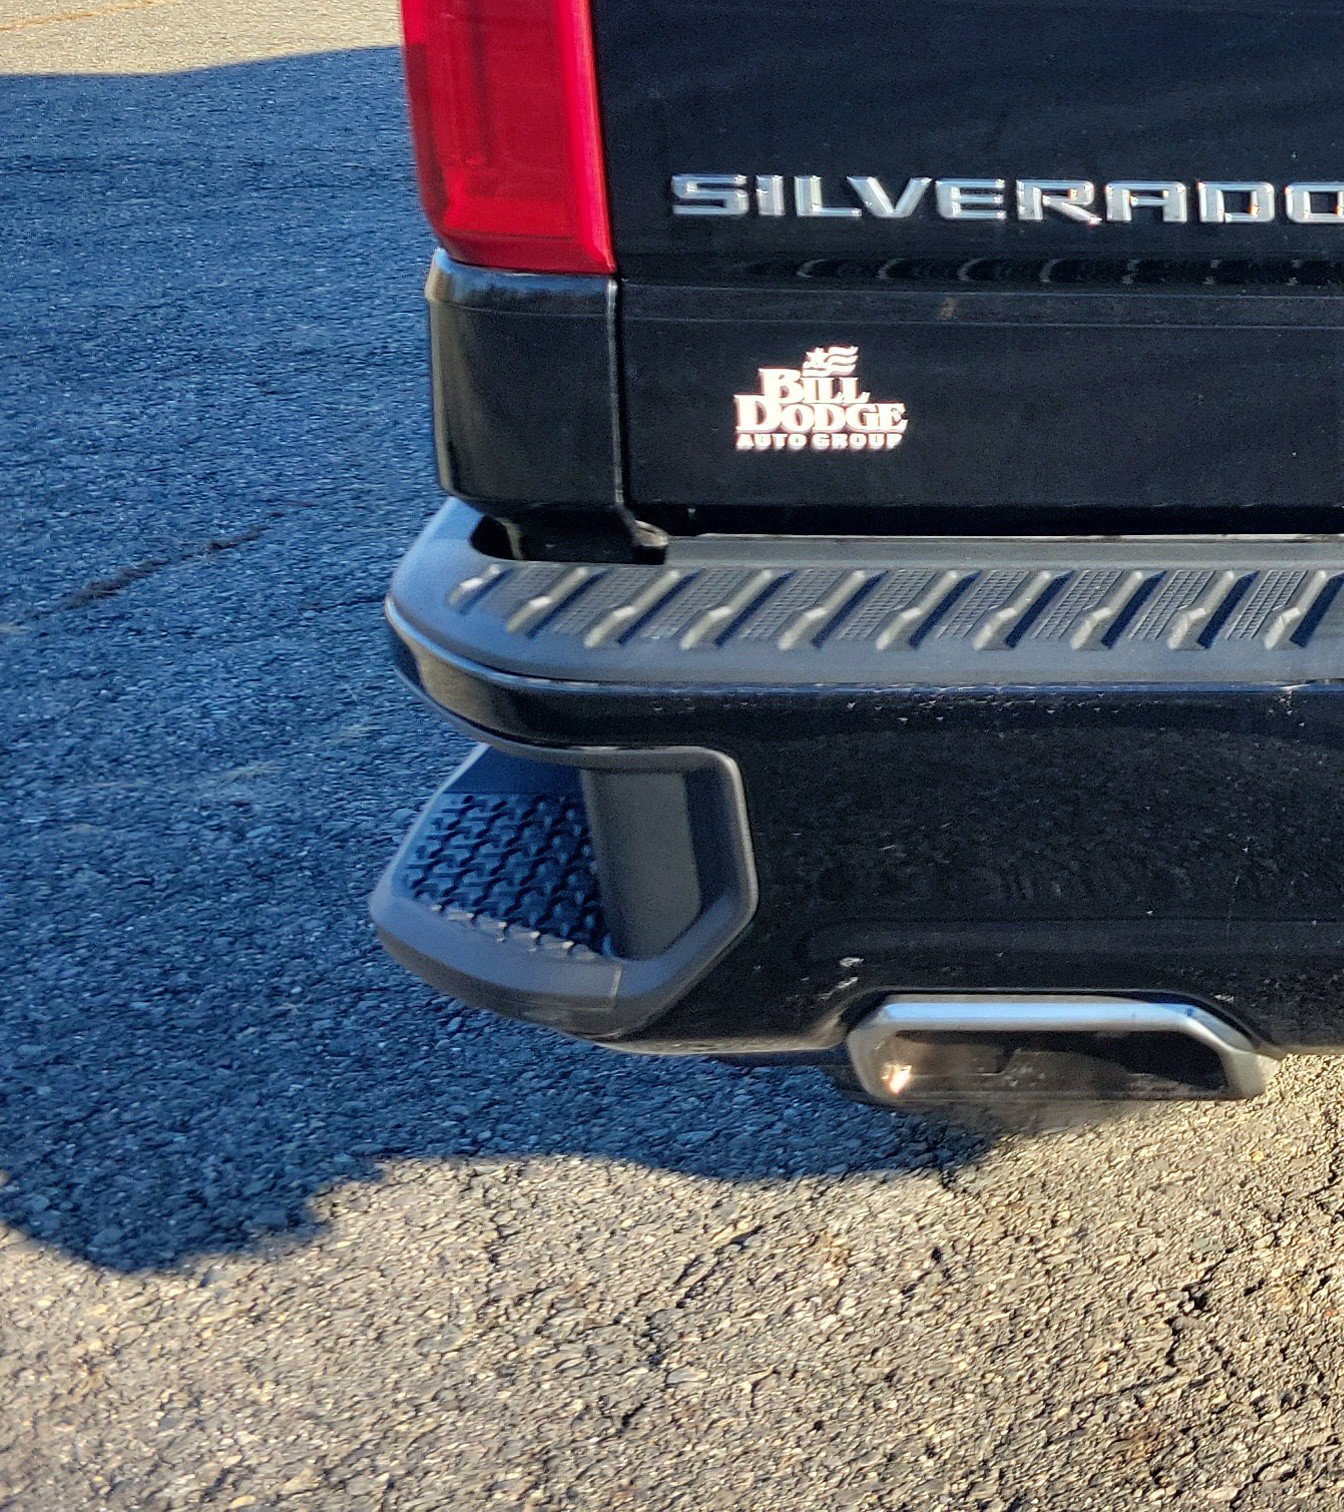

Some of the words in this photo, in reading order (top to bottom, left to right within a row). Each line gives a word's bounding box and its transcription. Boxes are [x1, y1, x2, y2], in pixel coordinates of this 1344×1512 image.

[758, 367, 871, 404] BILL
[733, 394, 908, 432] DODGE
[735, 433, 807, 450] AUTO
[811, 433, 903, 450] GROUP
